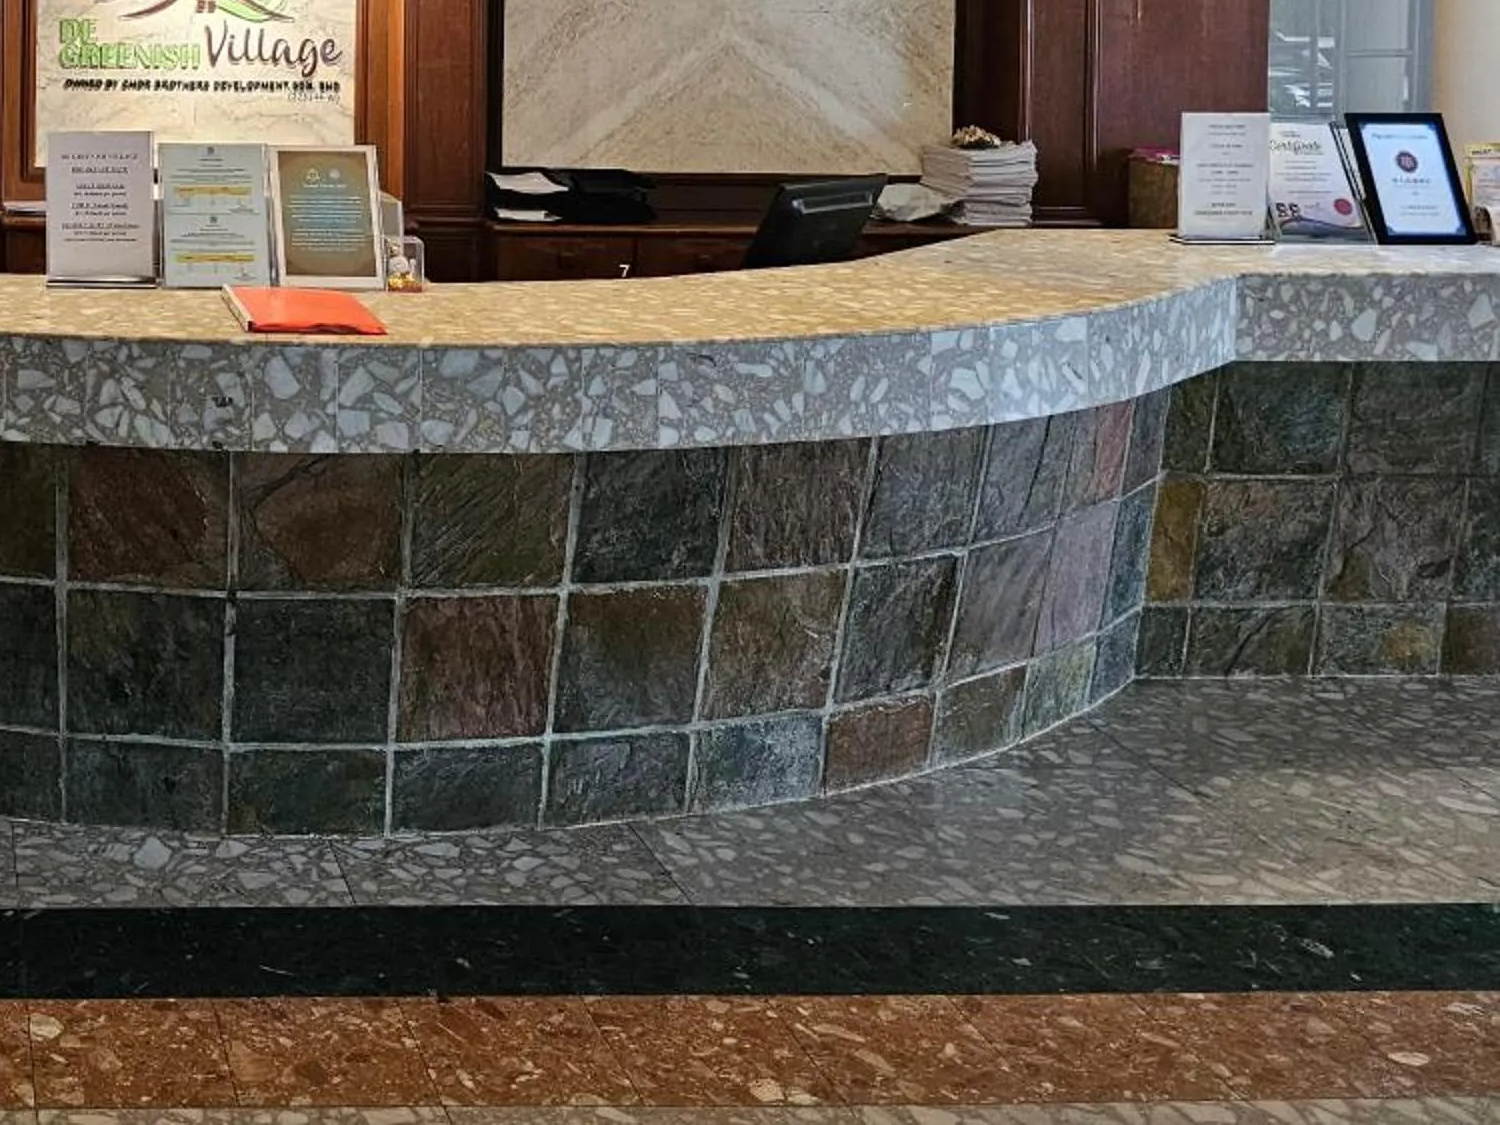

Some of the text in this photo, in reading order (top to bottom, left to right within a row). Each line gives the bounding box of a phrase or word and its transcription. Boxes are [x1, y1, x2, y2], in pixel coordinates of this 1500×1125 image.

[59, 19, 98, 43] DE
[59, 21, 342, 77] GREENISH Village
[213, 80, 289, 93] DEVELOPMENT
[619, 264, 630, 278] 7
